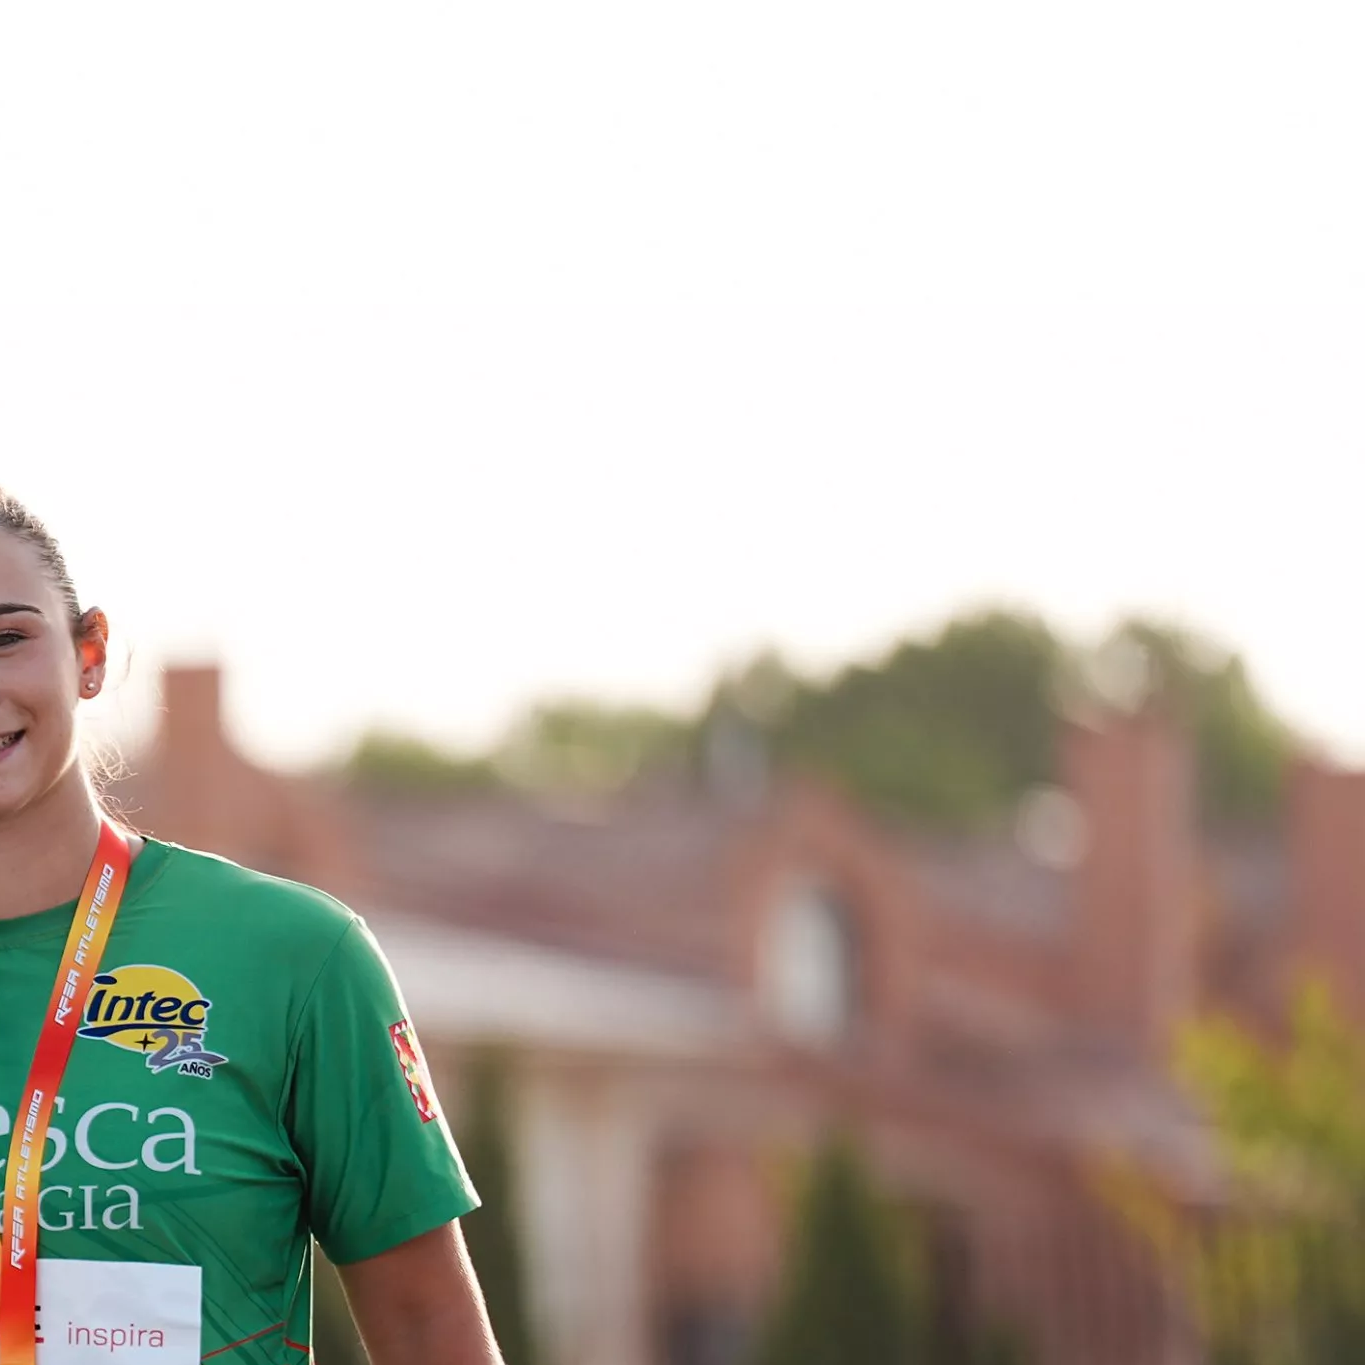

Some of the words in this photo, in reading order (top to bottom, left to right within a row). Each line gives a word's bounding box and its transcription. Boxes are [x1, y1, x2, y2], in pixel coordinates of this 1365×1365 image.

[54, 969, 81, 1026] RFEA
[74, 863, 115, 967] ATLETISMO
[147, 1028, 203, 1068] 25
[180, 1062, 212, 1078] AÑOS
[15, 1088, 44, 1200] ATLETISMO
[10, 1206, 26, 1270] RFEA
[68, 1321, 165, 1353] inspira
